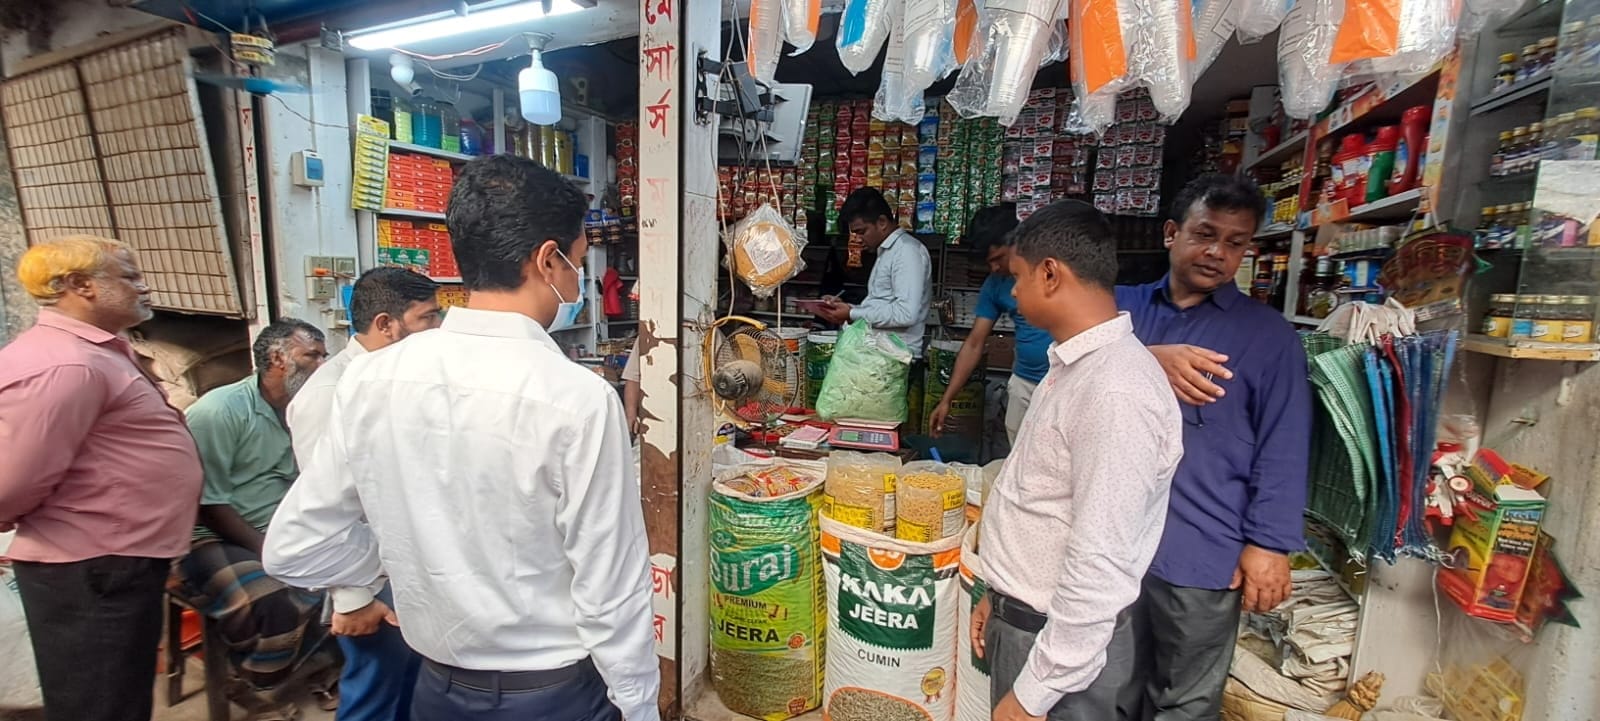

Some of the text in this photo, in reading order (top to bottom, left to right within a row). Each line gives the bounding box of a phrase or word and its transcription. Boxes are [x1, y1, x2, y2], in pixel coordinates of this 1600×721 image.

[710, 543, 793, 592] Suraj
[841, 573, 933, 607] KAKA
[724, 595, 767, 611] PREMIUM
[849, 603, 919, 630] JEERA
[719, 619, 780, 643] JEERA
[857, 648, 901, 668] CUMIN
